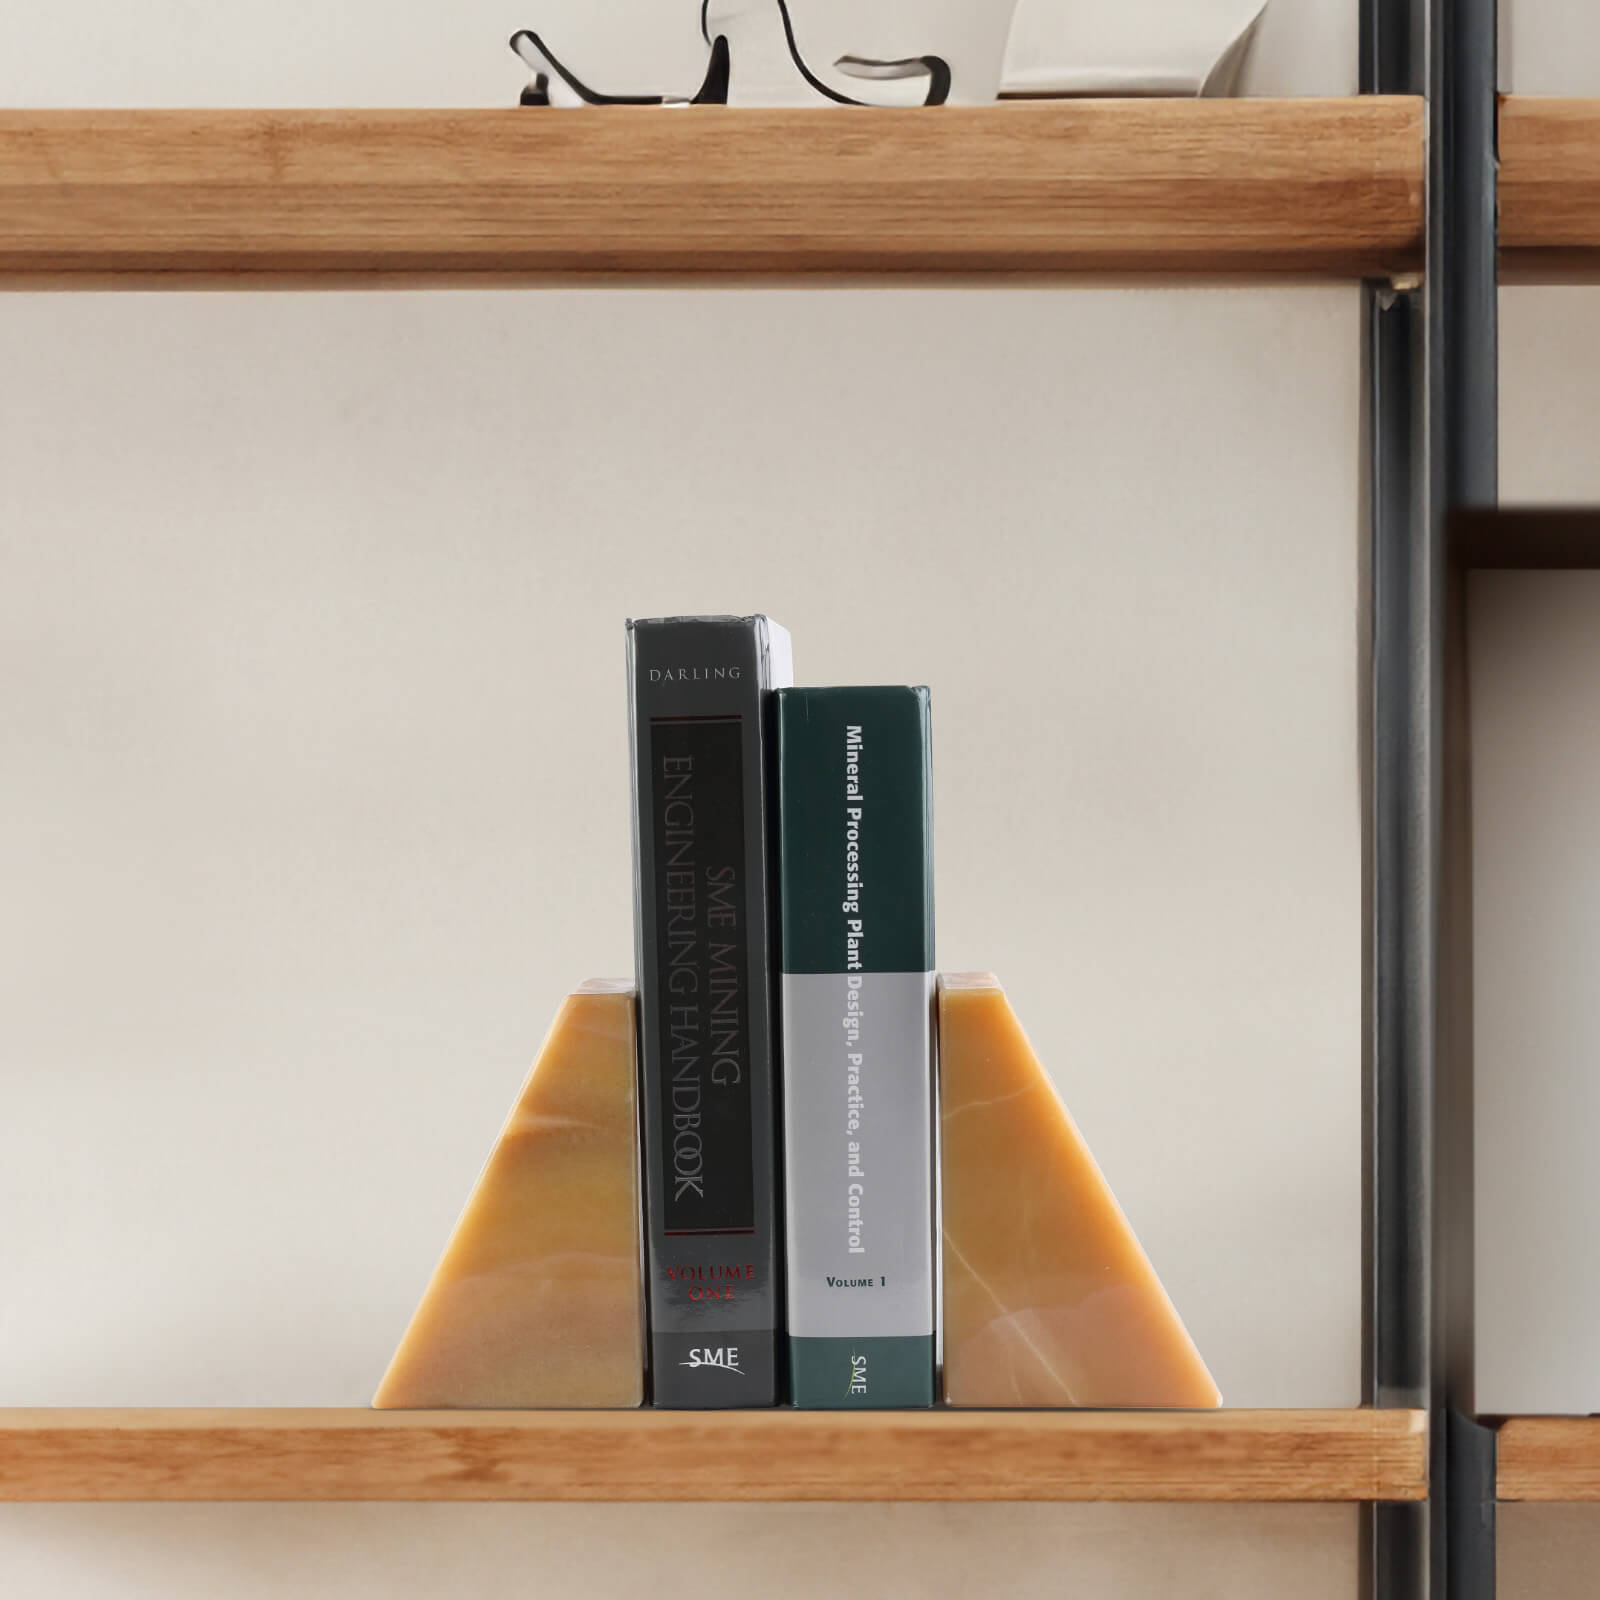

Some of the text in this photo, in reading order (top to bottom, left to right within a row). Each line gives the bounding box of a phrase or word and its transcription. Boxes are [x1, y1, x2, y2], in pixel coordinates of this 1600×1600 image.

[649, 666, 742, 682] DARLING
[663, 755, 704, 1202] ENGINEERING HANDBOOK
[705, 865, 742, 1086] SME MINING
[842, 725, 865, 1254] Mineral Processing Plant Design, Practice, and Control
[667, 1264, 756, 1281] VOLUME
[880, 1276, 886, 1287] 1
[688, 1285, 736, 1301] ONE
[688, 1347, 739, 1367] SME
[851, 1355, 867, 1394] SME
